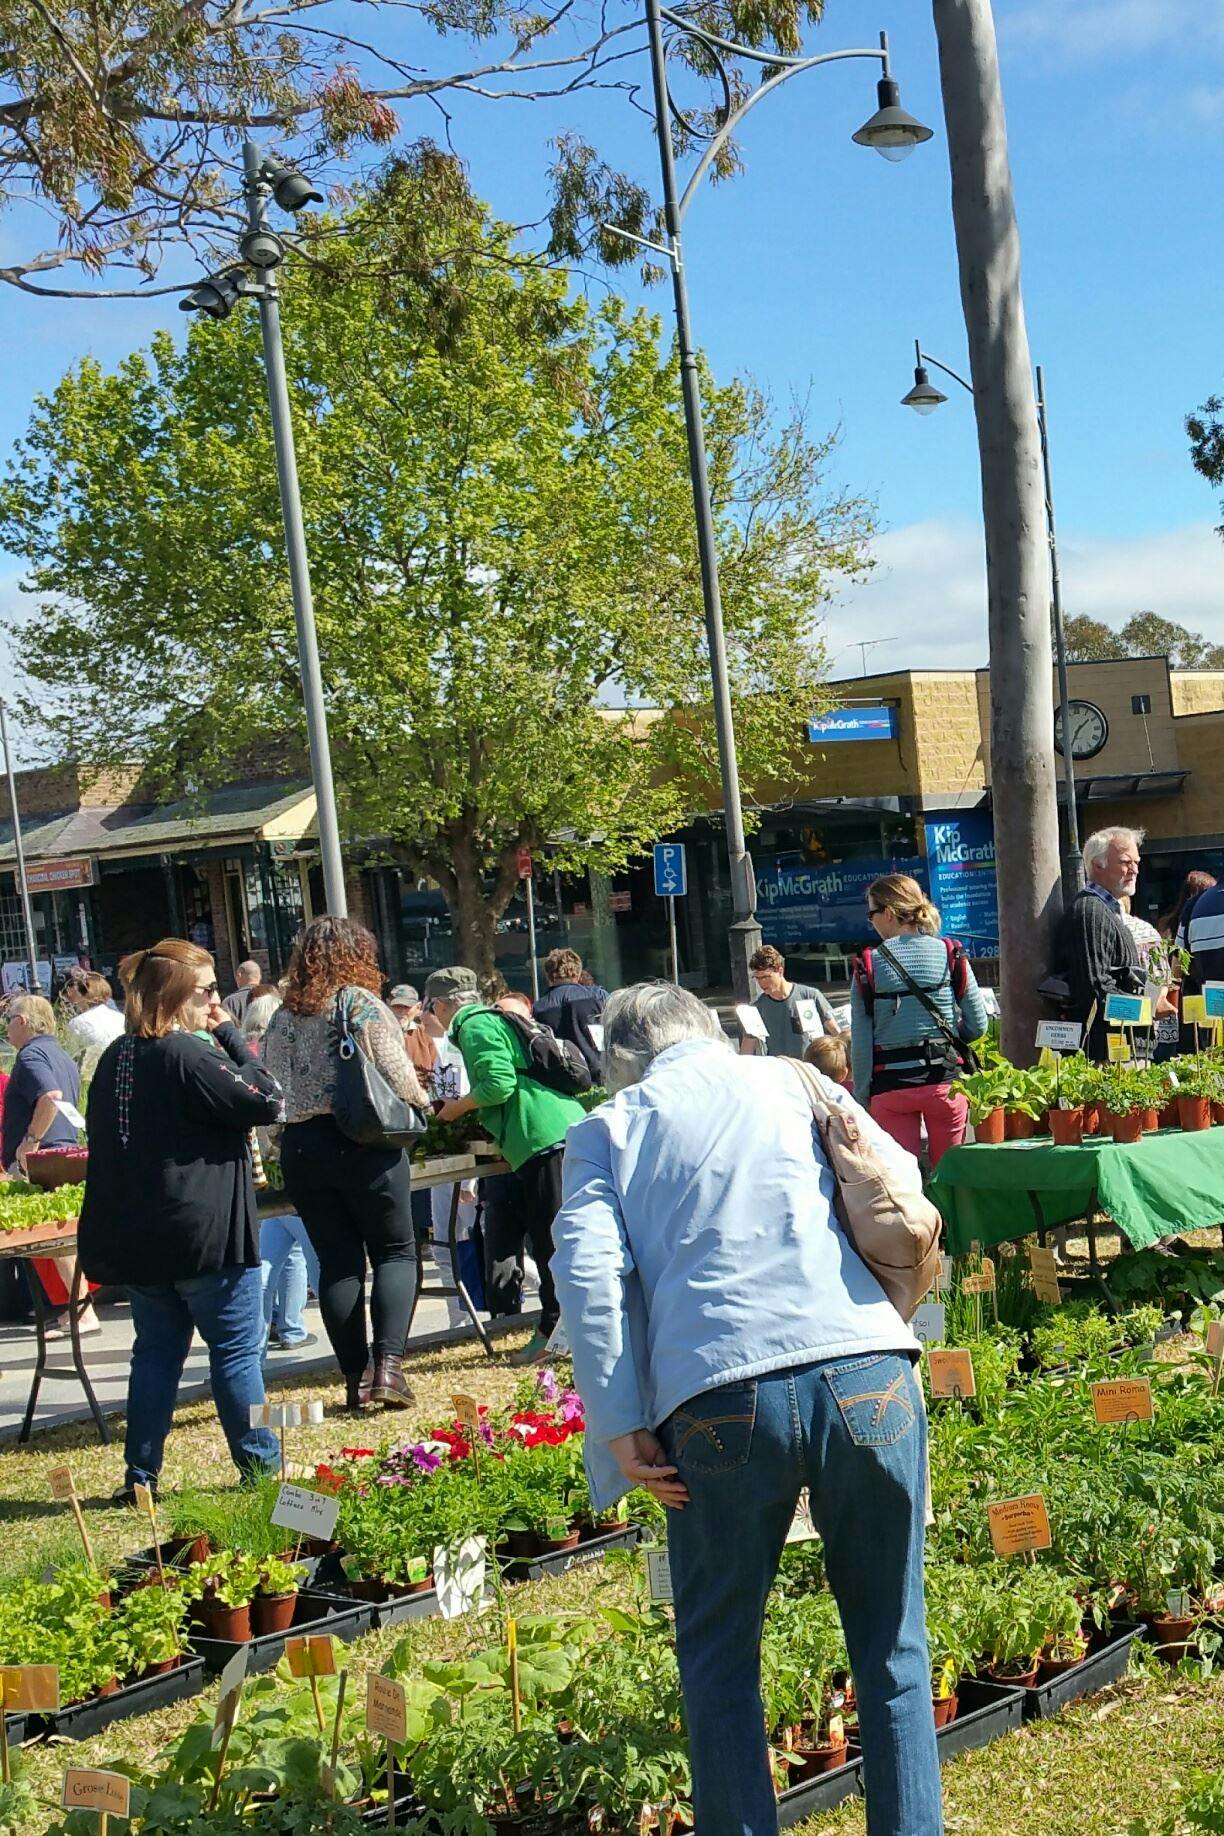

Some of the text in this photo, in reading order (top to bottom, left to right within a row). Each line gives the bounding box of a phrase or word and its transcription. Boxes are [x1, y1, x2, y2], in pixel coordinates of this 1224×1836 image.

[934, 825, 960, 850] Kip
[663, 848, 674, 862] P
[936, 841, 996, 863] McGrath
[939, 871, 974, 881] EDUCATION
[1097, 1385, 1145, 1397] Mini Roma
[991, 1504, 1019, 1517] Medium
